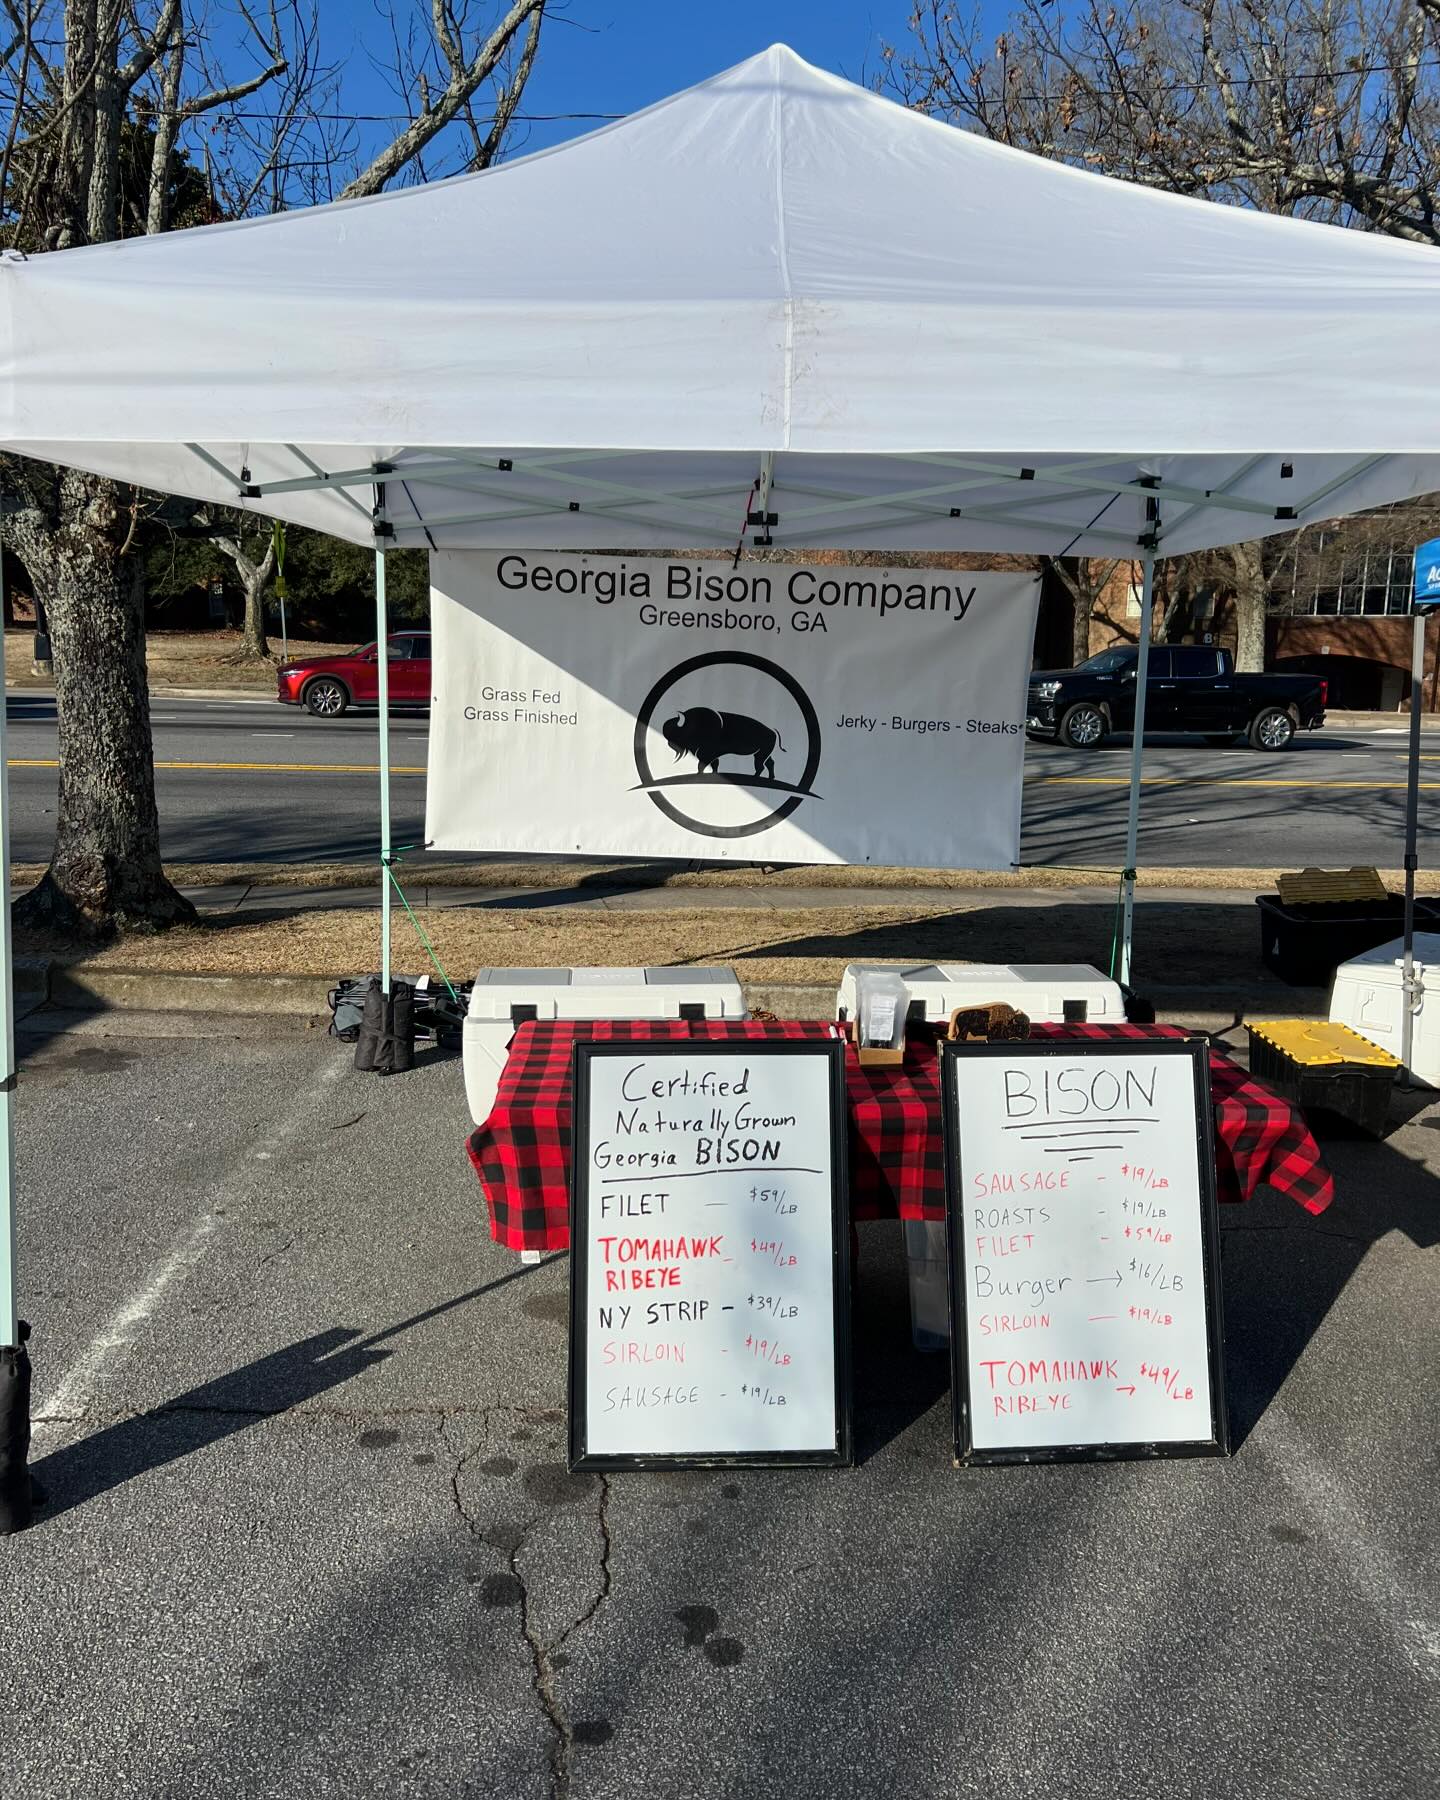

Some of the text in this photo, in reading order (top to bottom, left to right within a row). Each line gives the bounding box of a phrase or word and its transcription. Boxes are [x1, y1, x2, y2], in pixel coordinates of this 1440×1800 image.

[497, 555, 977, 621] Georgia Bison Company
[639, 604, 828, 634] Greensboro, GA
[481, 686, 561, 703] Grass Fed
[464, 706, 577, 725] Grass Finished
[836, 714, 877, 732] Jerky
[892, 716, 951, 734] Burgers
[966, 719, 1018, 735] Steaks
[622, 1063, 749, 1101] Certified
[1004, 1066, 1157, 1118] BISON
[616, 1102, 796, 1139] Naturally Grown
[594, 1137, 781, 1169] Georgia BISON
[974, 1170, 1071, 1198] SAUSAGE
[1121, 1163, 1169, 1189] $19/LB
[601, 1193, 670, 1218] FILET
[974, 1207, 1051, 1229] ROASTS
[1122, 1196, 1167, 1218] $19/LB
[597, 1235, 724, 1264] TOMAHAWK
[975, 1234, 1035, 1257] FILET
[605, 1266, 682, 1292] RIBEYE
[974, 1257, 1184, 1308] Burger $16/LB
[599, 1306, 631, 1329] NY
[647, 1300, 709, 1325] STRIP
[747, 1295, 799, 1319] $39/LB
[979, 1305, 1174, 1336] SIRLOIN $19/LB
[603, 1341, 686, 1365] SIRLOIN
[746, 1334, 792, 1366] $19/LB
[980, 1359, 1195, 1401] TOMAHAWK $49/LB
[603, 1386, 700, 1413] SAUSAGE
[741, 1384, 787, 1406] $19/LB
